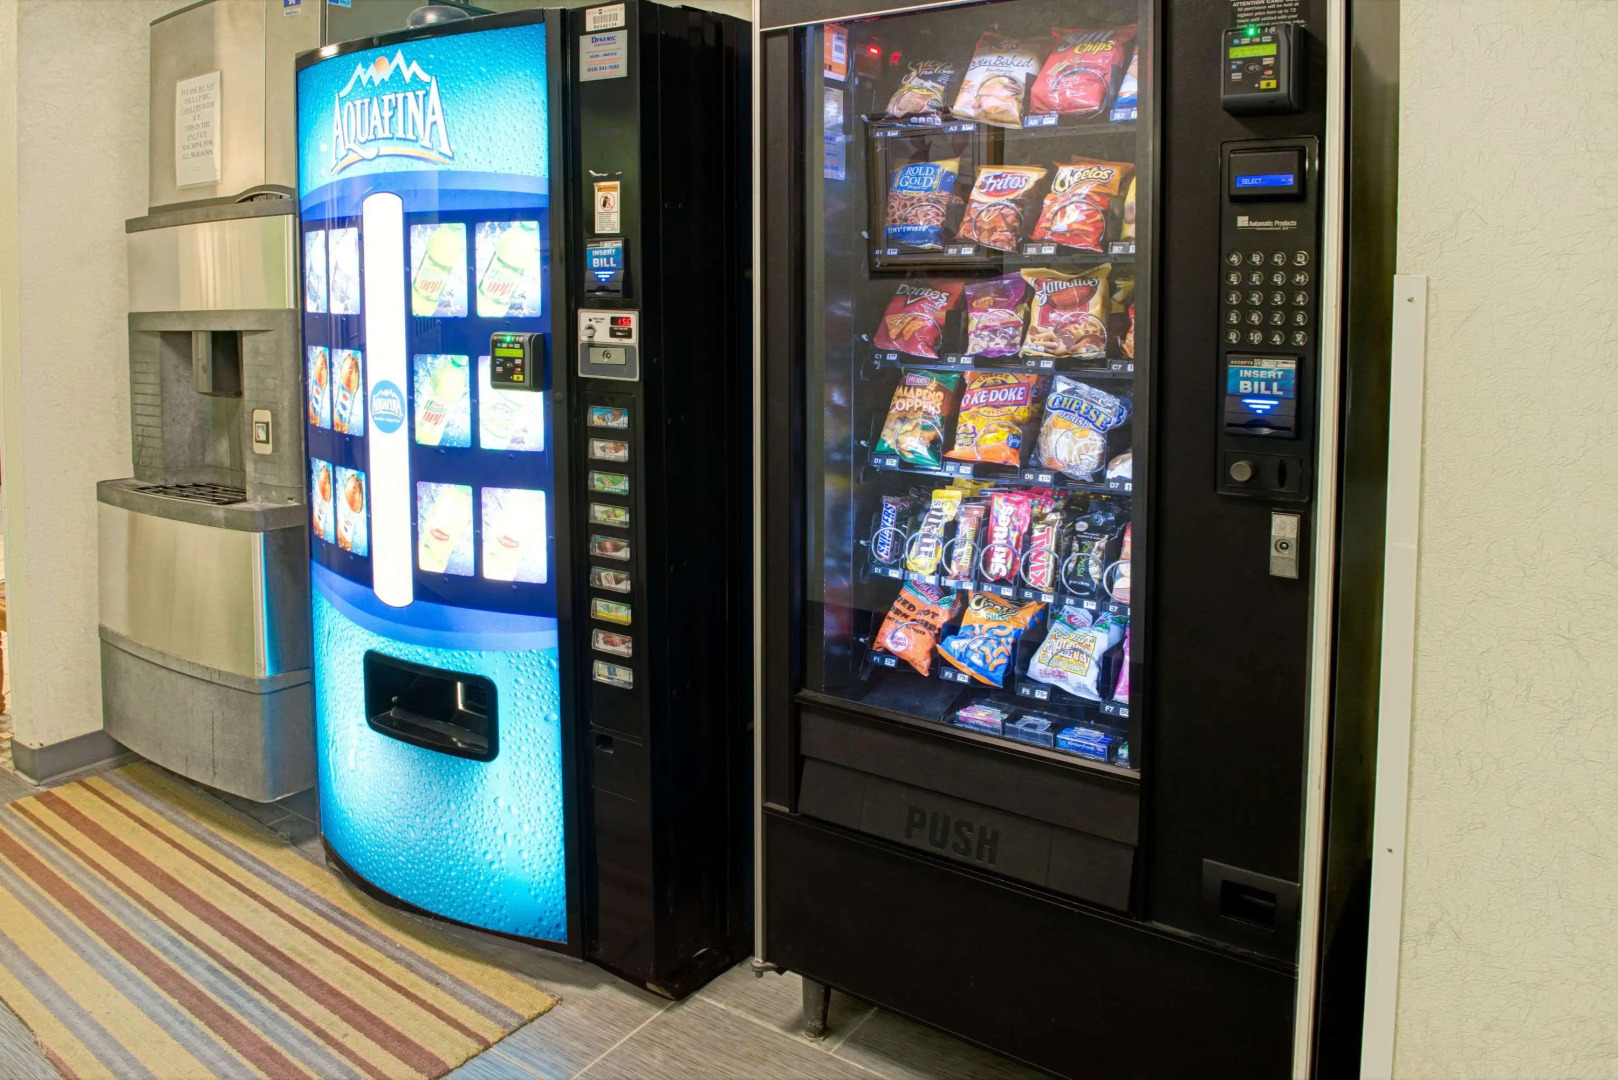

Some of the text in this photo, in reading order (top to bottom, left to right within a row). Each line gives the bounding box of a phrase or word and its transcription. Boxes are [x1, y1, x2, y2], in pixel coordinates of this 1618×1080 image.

[1074, 40, 1114, 54] Chips
[995, 55, 1034, 68] Baked
[331, 75, 454, 172] AQUAFINA
[906, 167, 934, 176] ROLD
[1054, 166, 1114, 193] Cheetos
[900, 176, 934, 188] GOLD
[979, 172, 1029, 193] Fritos
[592, 258, 616, 268] BILL
[895, 284, 950, 302] Doritos
[1240, 370, 1284, 380] INSERT
[1239, 380, 1284, 394] BILL
[1047, 394, 1112, 431] CHEESE
[1060, 410, 1089, 428] Danish
[877, 502, 896, 557] SNICKERS
[1029, 526, 1052, 587] TWIX
[905, 805, 999, 865] PUSH
